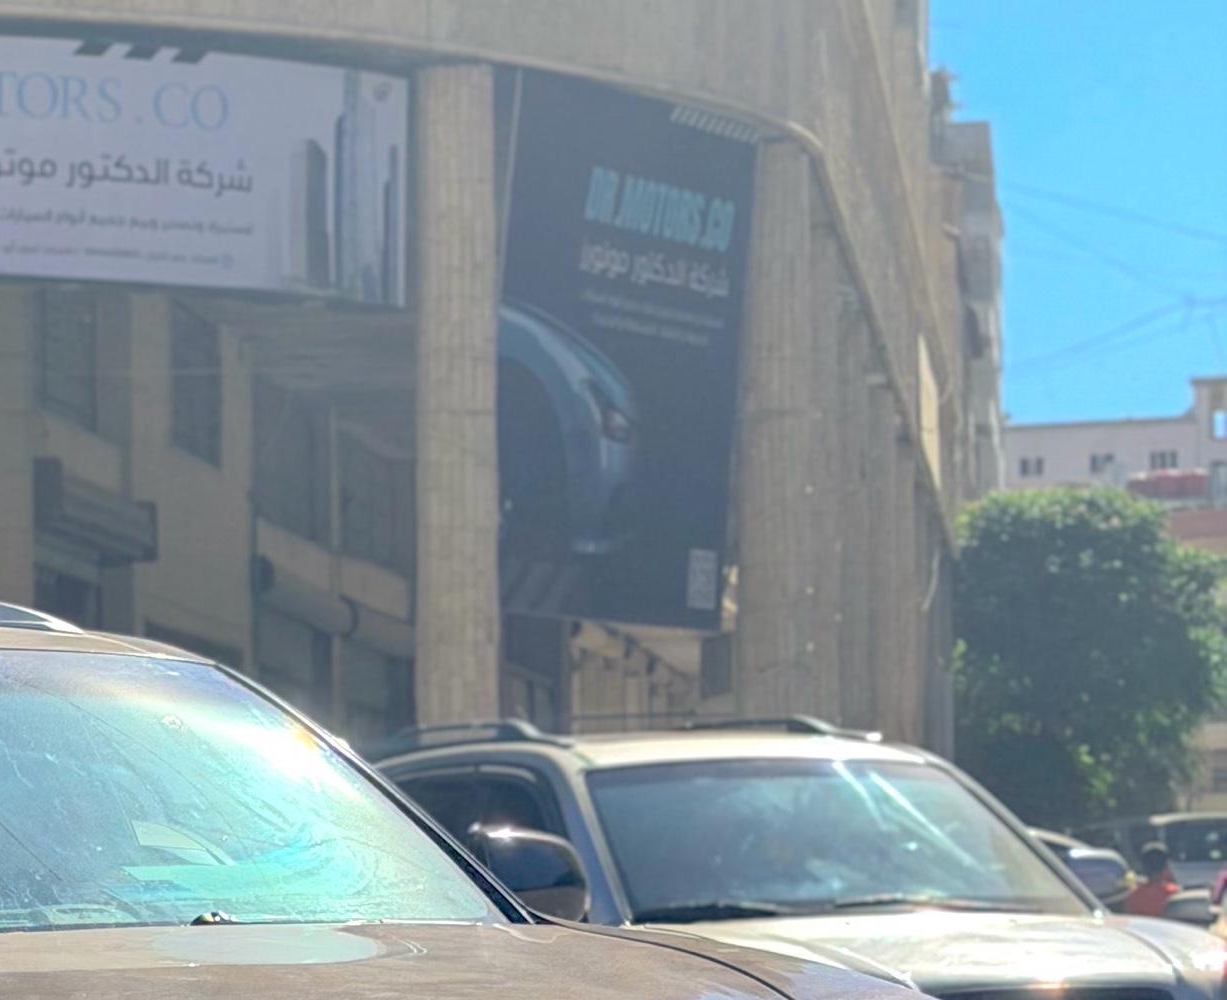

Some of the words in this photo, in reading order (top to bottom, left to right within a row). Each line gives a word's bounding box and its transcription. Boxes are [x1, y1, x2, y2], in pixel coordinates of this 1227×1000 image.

[65, 153, 168, 188] الدكتور
[177, 159, 254, 198] شركة
[630, 250, 687, 286] الدكتور
[688, 261, 730, 299] شركة
